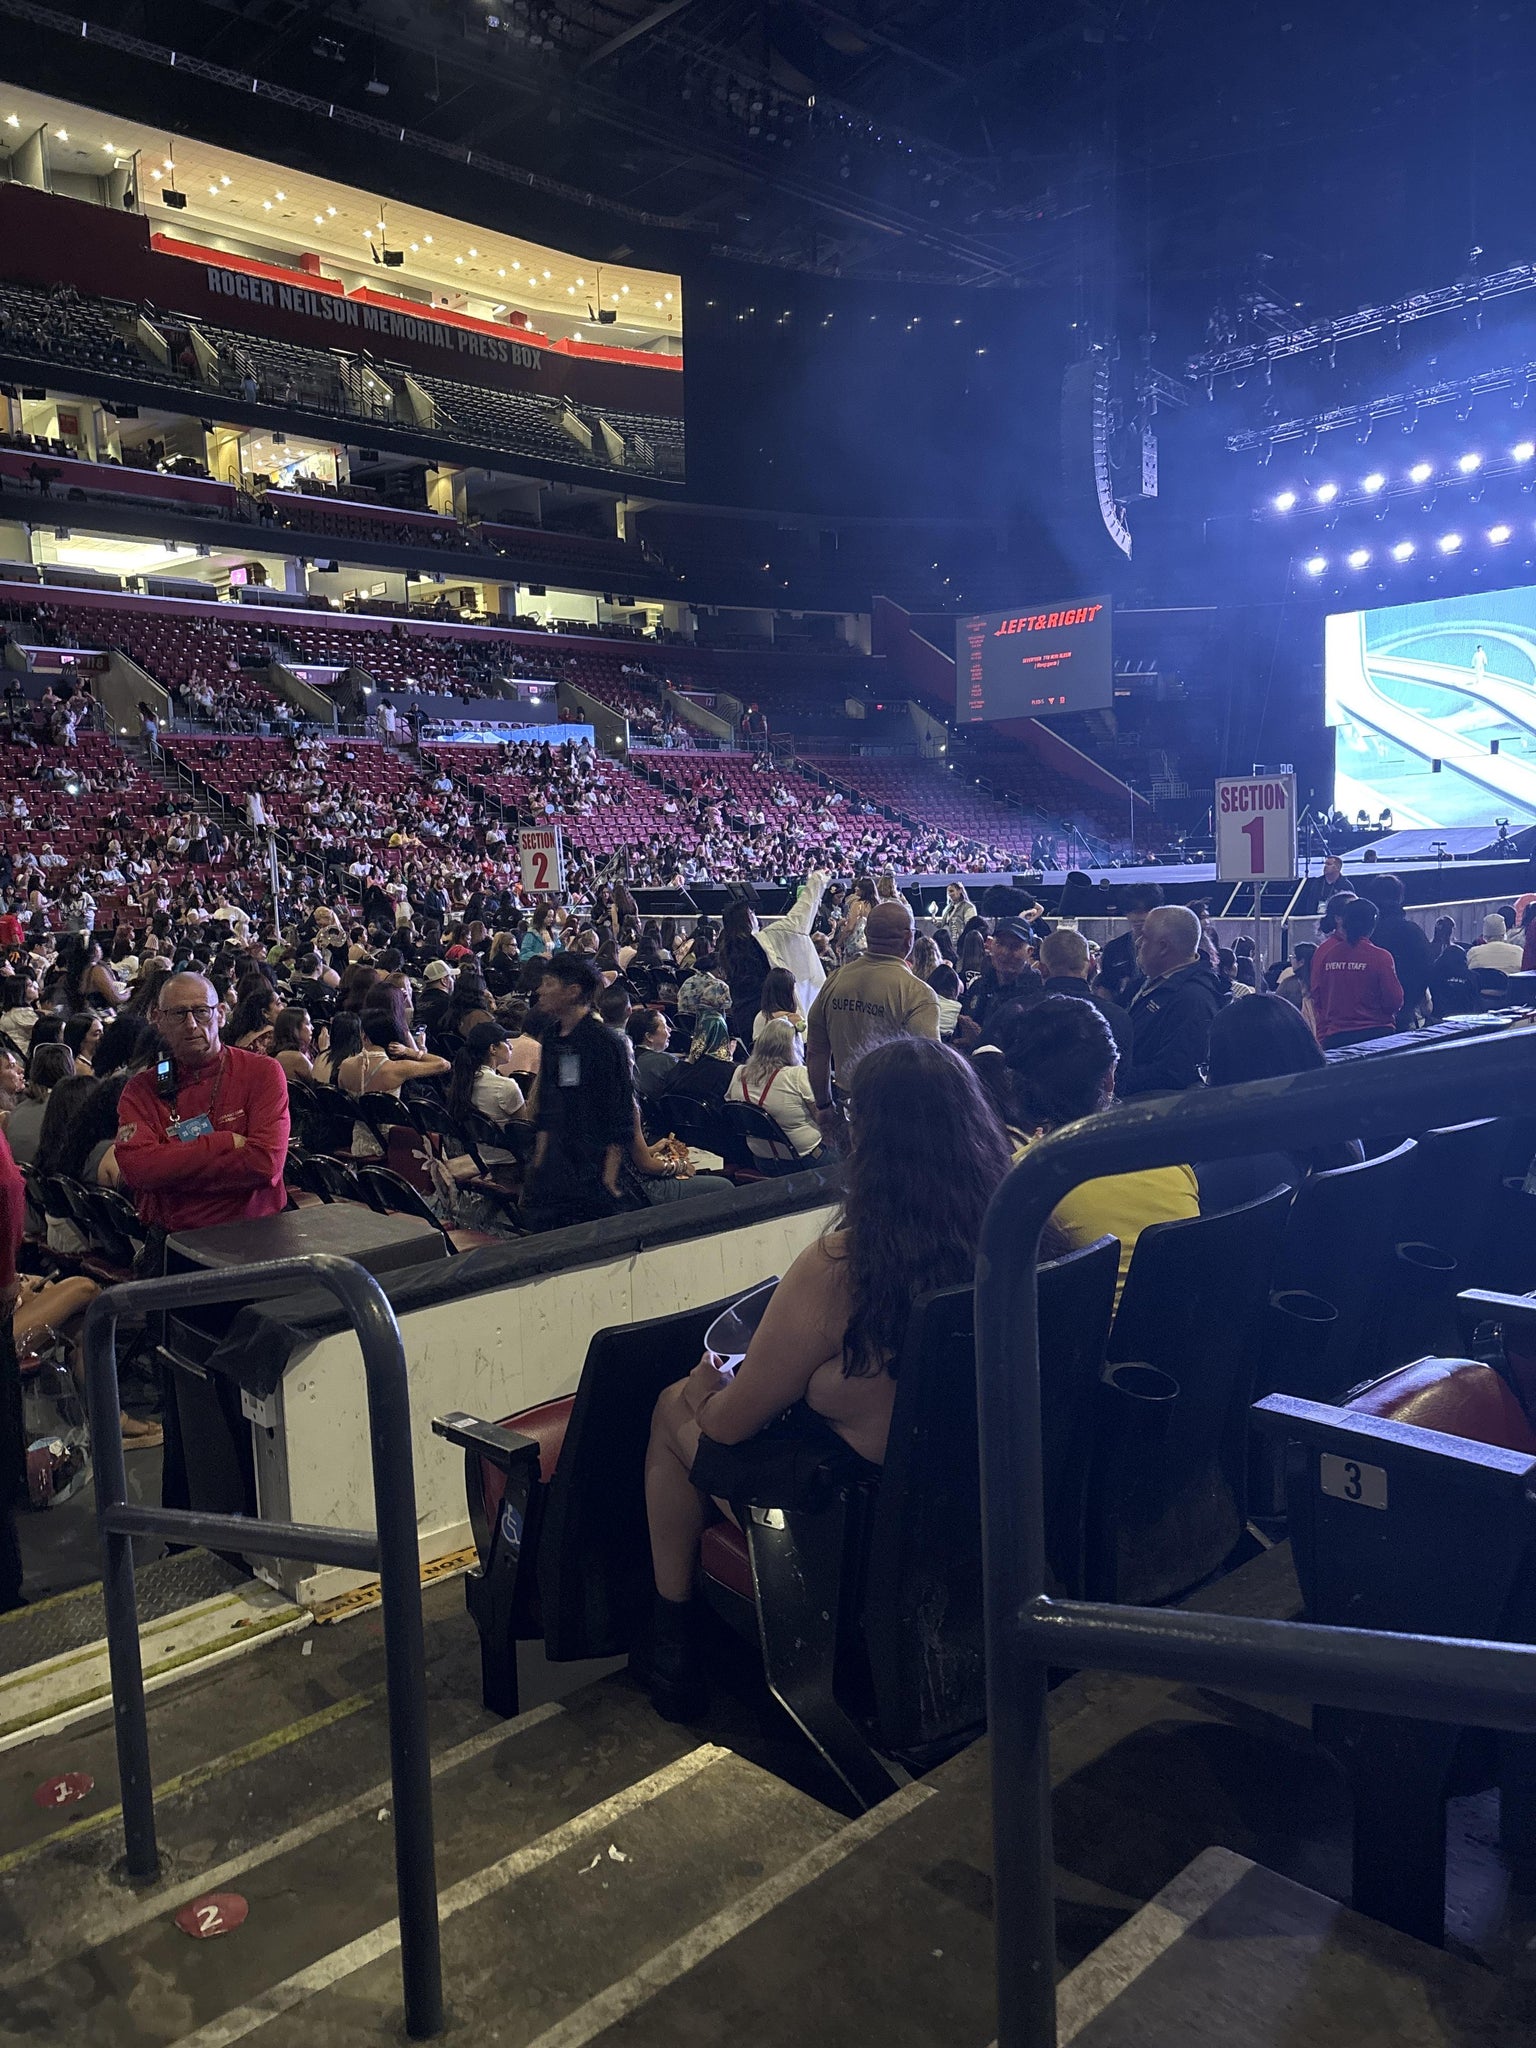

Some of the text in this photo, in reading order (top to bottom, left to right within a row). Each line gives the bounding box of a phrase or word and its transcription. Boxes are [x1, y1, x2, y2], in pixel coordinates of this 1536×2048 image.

[206, 267, 542, 371] ROGER NEILSON MEMORIAL PRESS BOX
[994, 604, 1102, 637] LEFT&RIGHT
[1220, 783, 1286, 813] SECTION
[521, 832, 555, 850] SECTION
[1241, 816, 1264, 874] 1
[532, 852, 550, 890] 2
[1325, 961, 1367, 971] EVENT STAFF
[832, 998, 885, 1018] SUPERVISOR
[1344, 1462, 1362, 1500] 3
[424, 1556, 464, 1575] NOT
[54, 1781, 73, 1803] 1
[196, 1904, 223, 1932] 2
